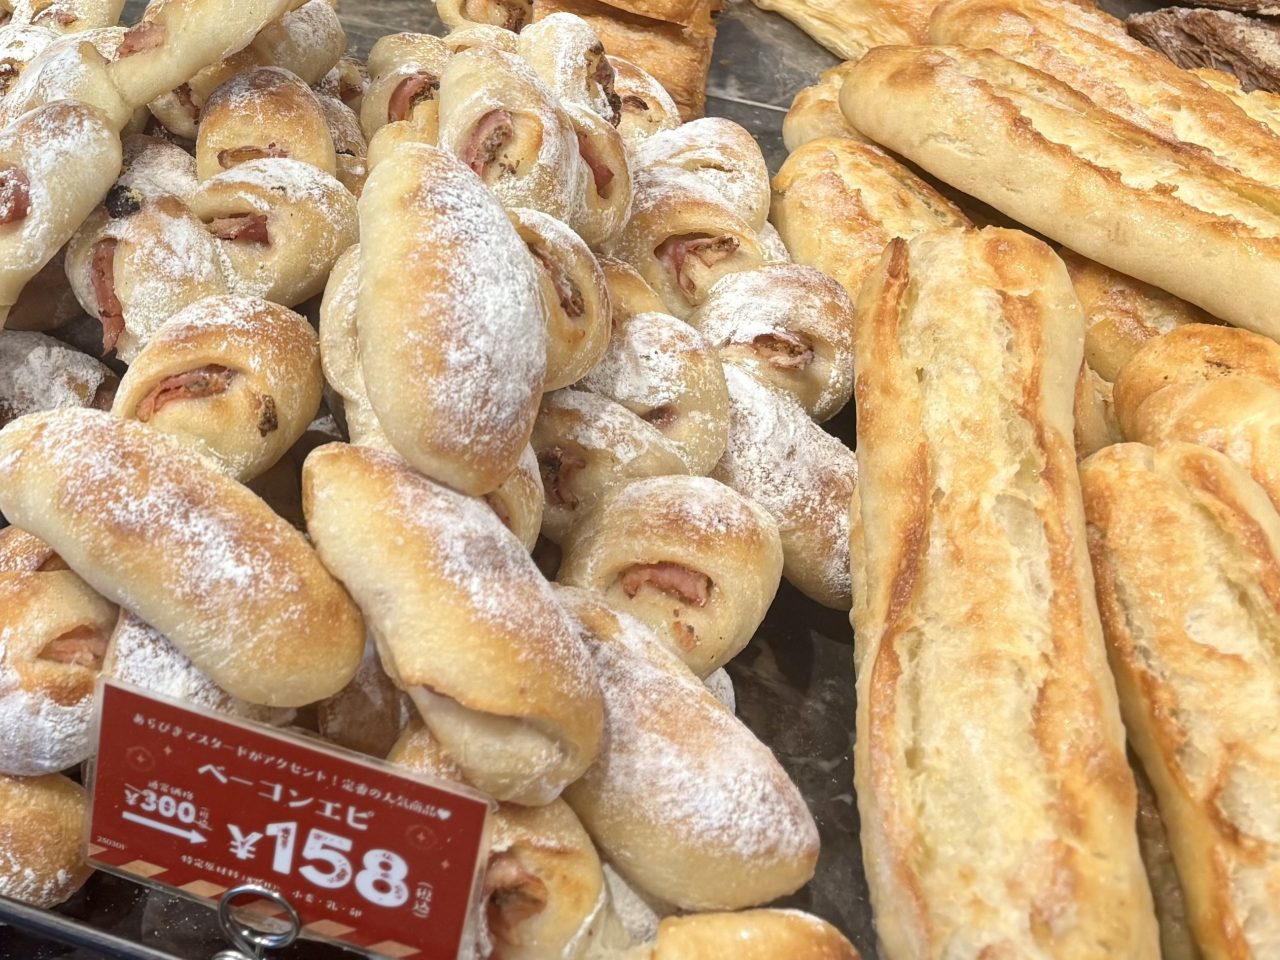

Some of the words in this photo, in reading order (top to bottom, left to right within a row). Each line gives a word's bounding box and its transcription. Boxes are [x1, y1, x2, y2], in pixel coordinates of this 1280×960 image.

[125, 787, 197, 824] ¥300
[197, 763, 375, 831] ベーコンエピ
[227, 821, 410, 908] ¥158
[412, 881, 433, 918] (税込)
